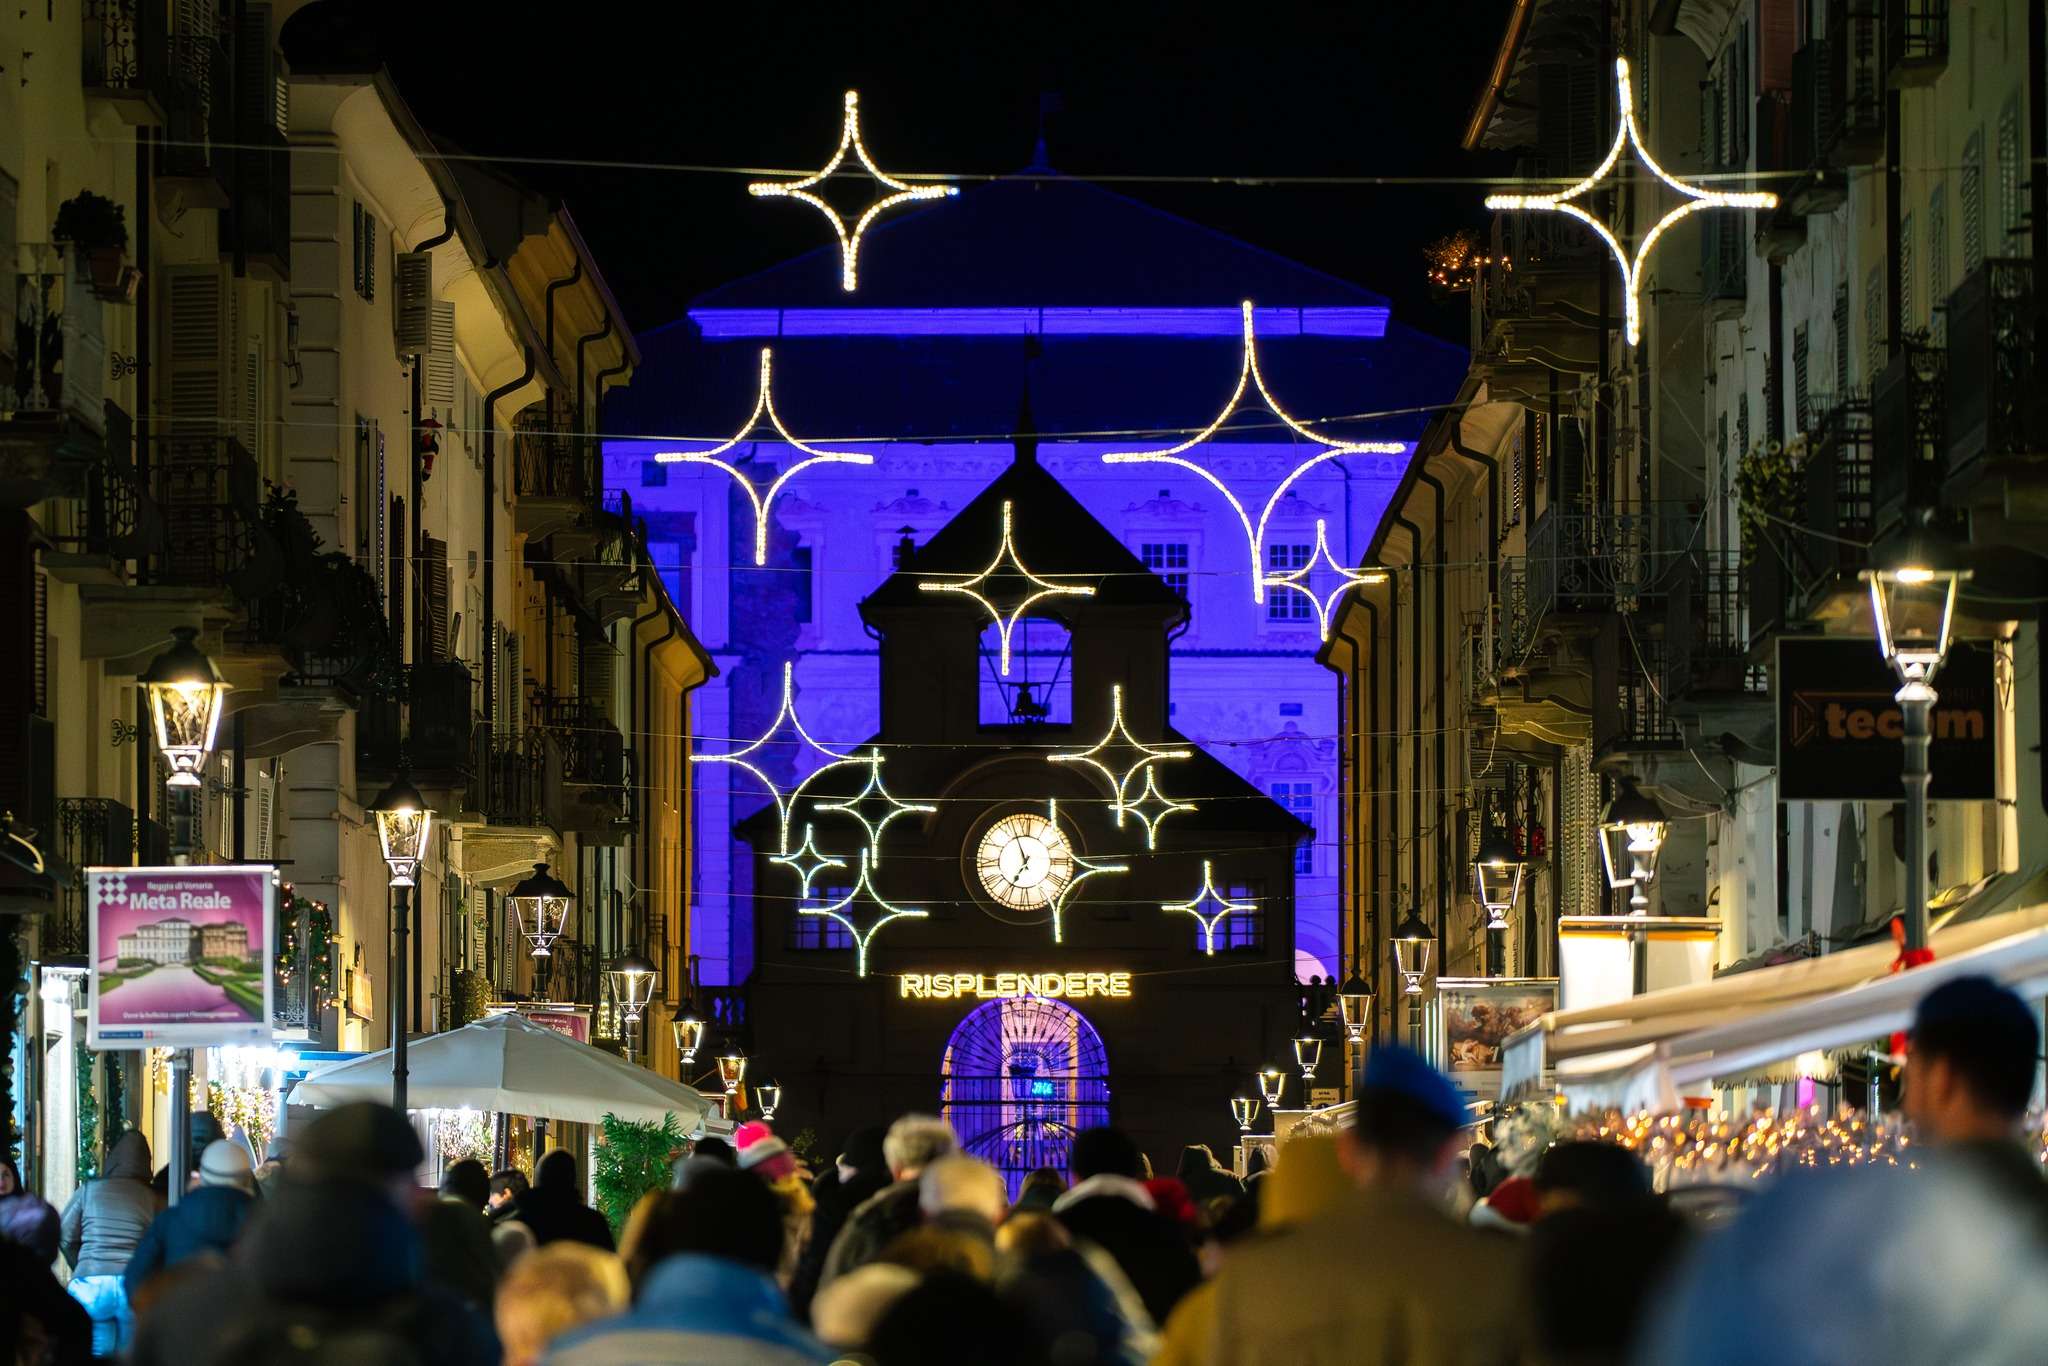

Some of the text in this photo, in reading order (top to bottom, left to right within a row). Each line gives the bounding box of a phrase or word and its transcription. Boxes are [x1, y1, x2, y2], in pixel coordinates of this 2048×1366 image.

[1825, 702, 1984, 739] tecm
[129, 892, 231, 910] Meta Reale
[901, 973, 1131, 998] RISPLENDERE
